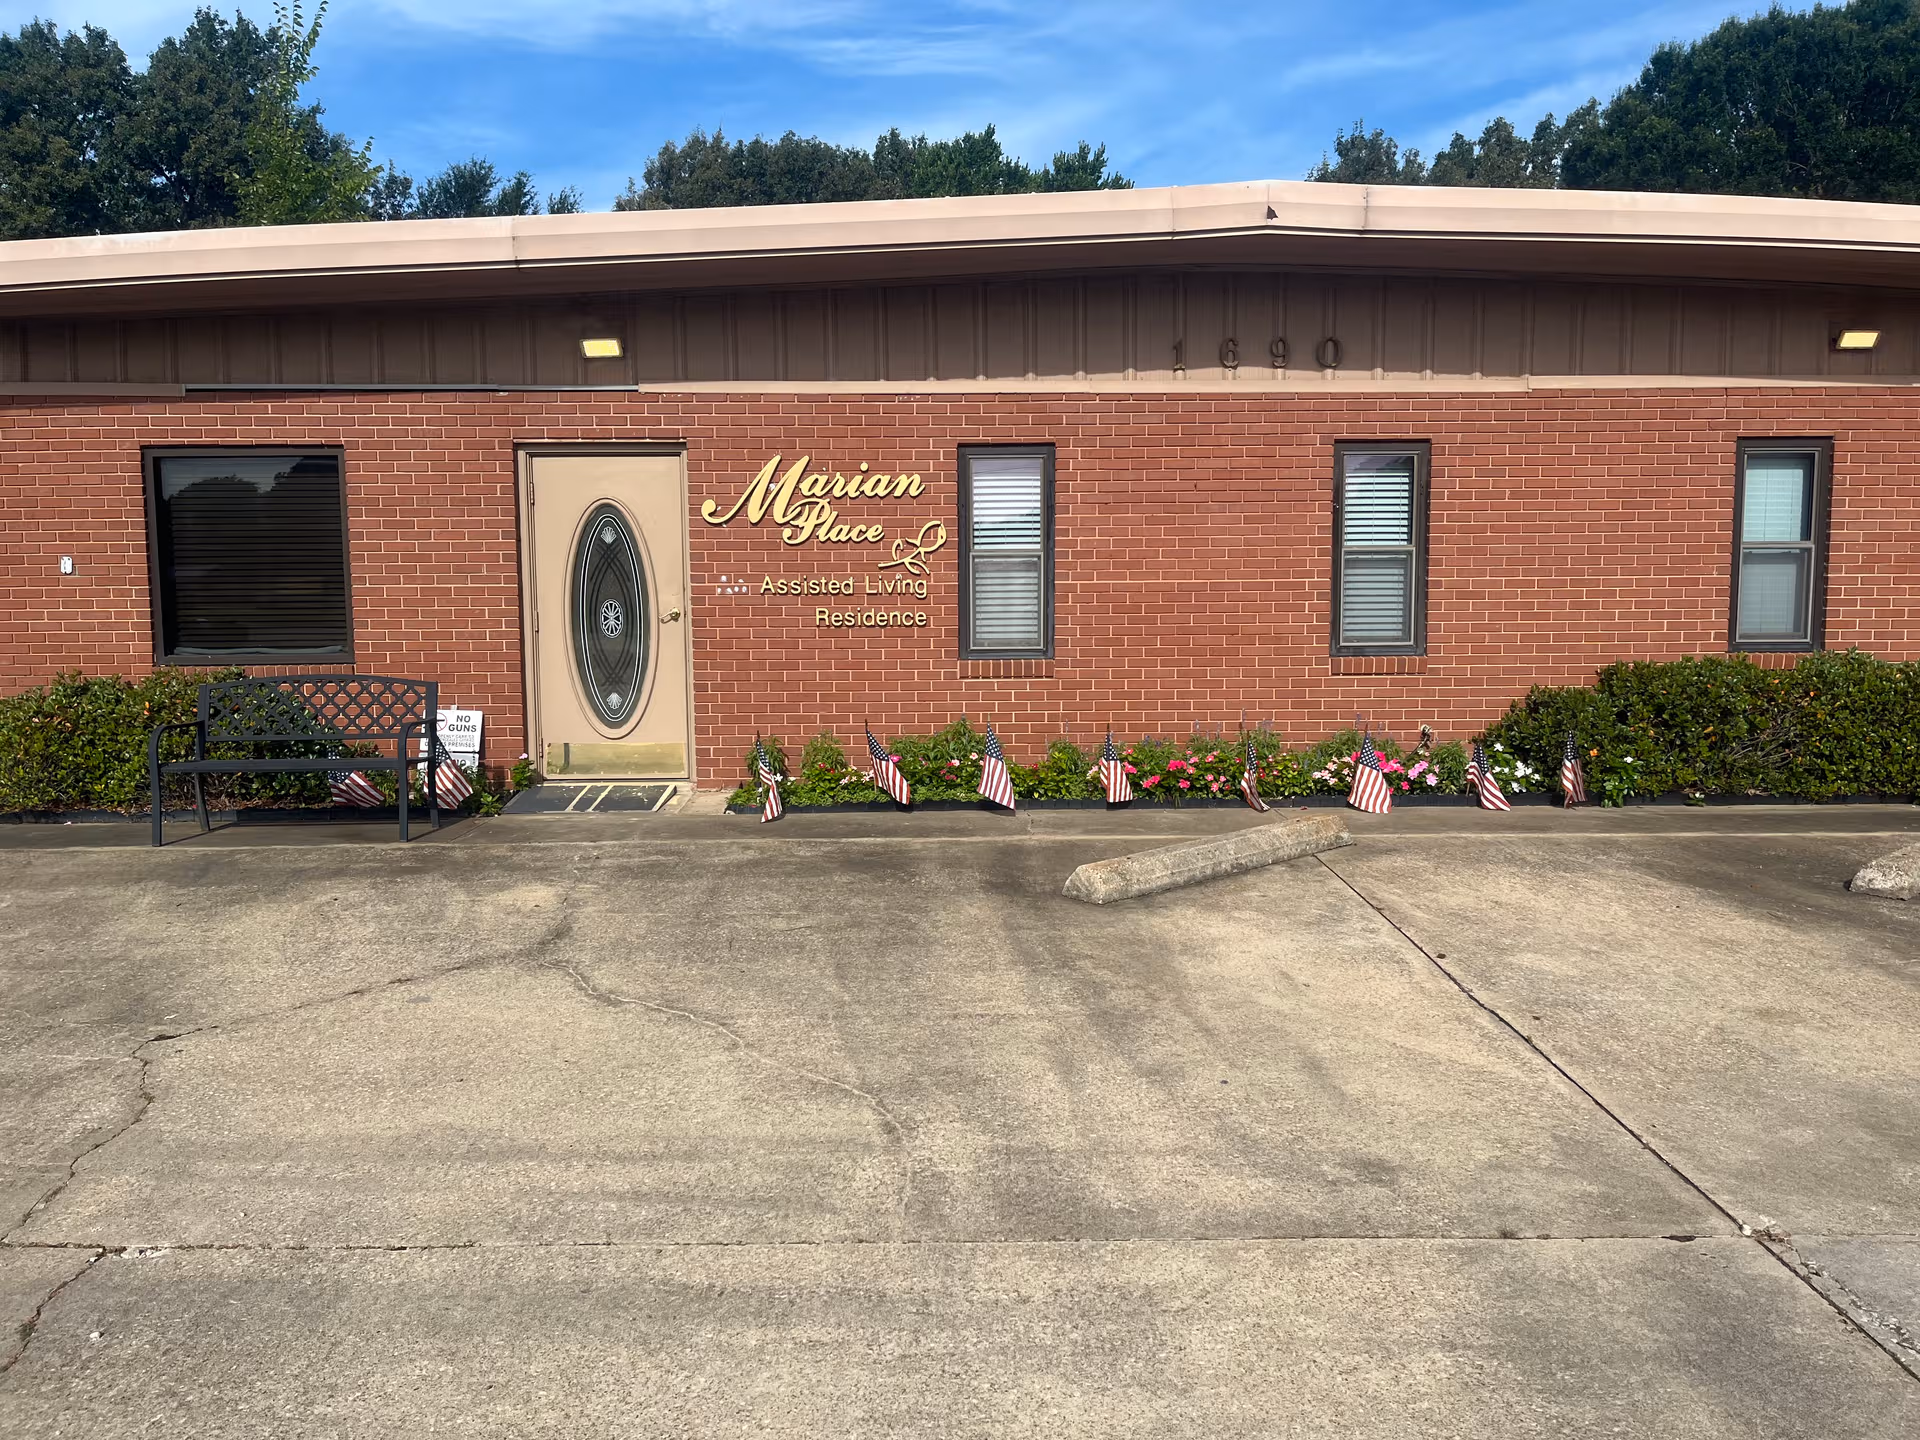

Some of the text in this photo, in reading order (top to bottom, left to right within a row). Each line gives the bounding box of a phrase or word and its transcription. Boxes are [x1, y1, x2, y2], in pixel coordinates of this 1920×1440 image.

[1173, 337, 1343, 371] 1690
[701, 454, 925, 524] Marian
[782, 498, 884, 545] Place
[760, 575, 928, 598] Assisted Living
[815, 607, 928, 627] Residence
[448, 724, 477, 732] GUNS
[456, 715, 471, 723] NO
